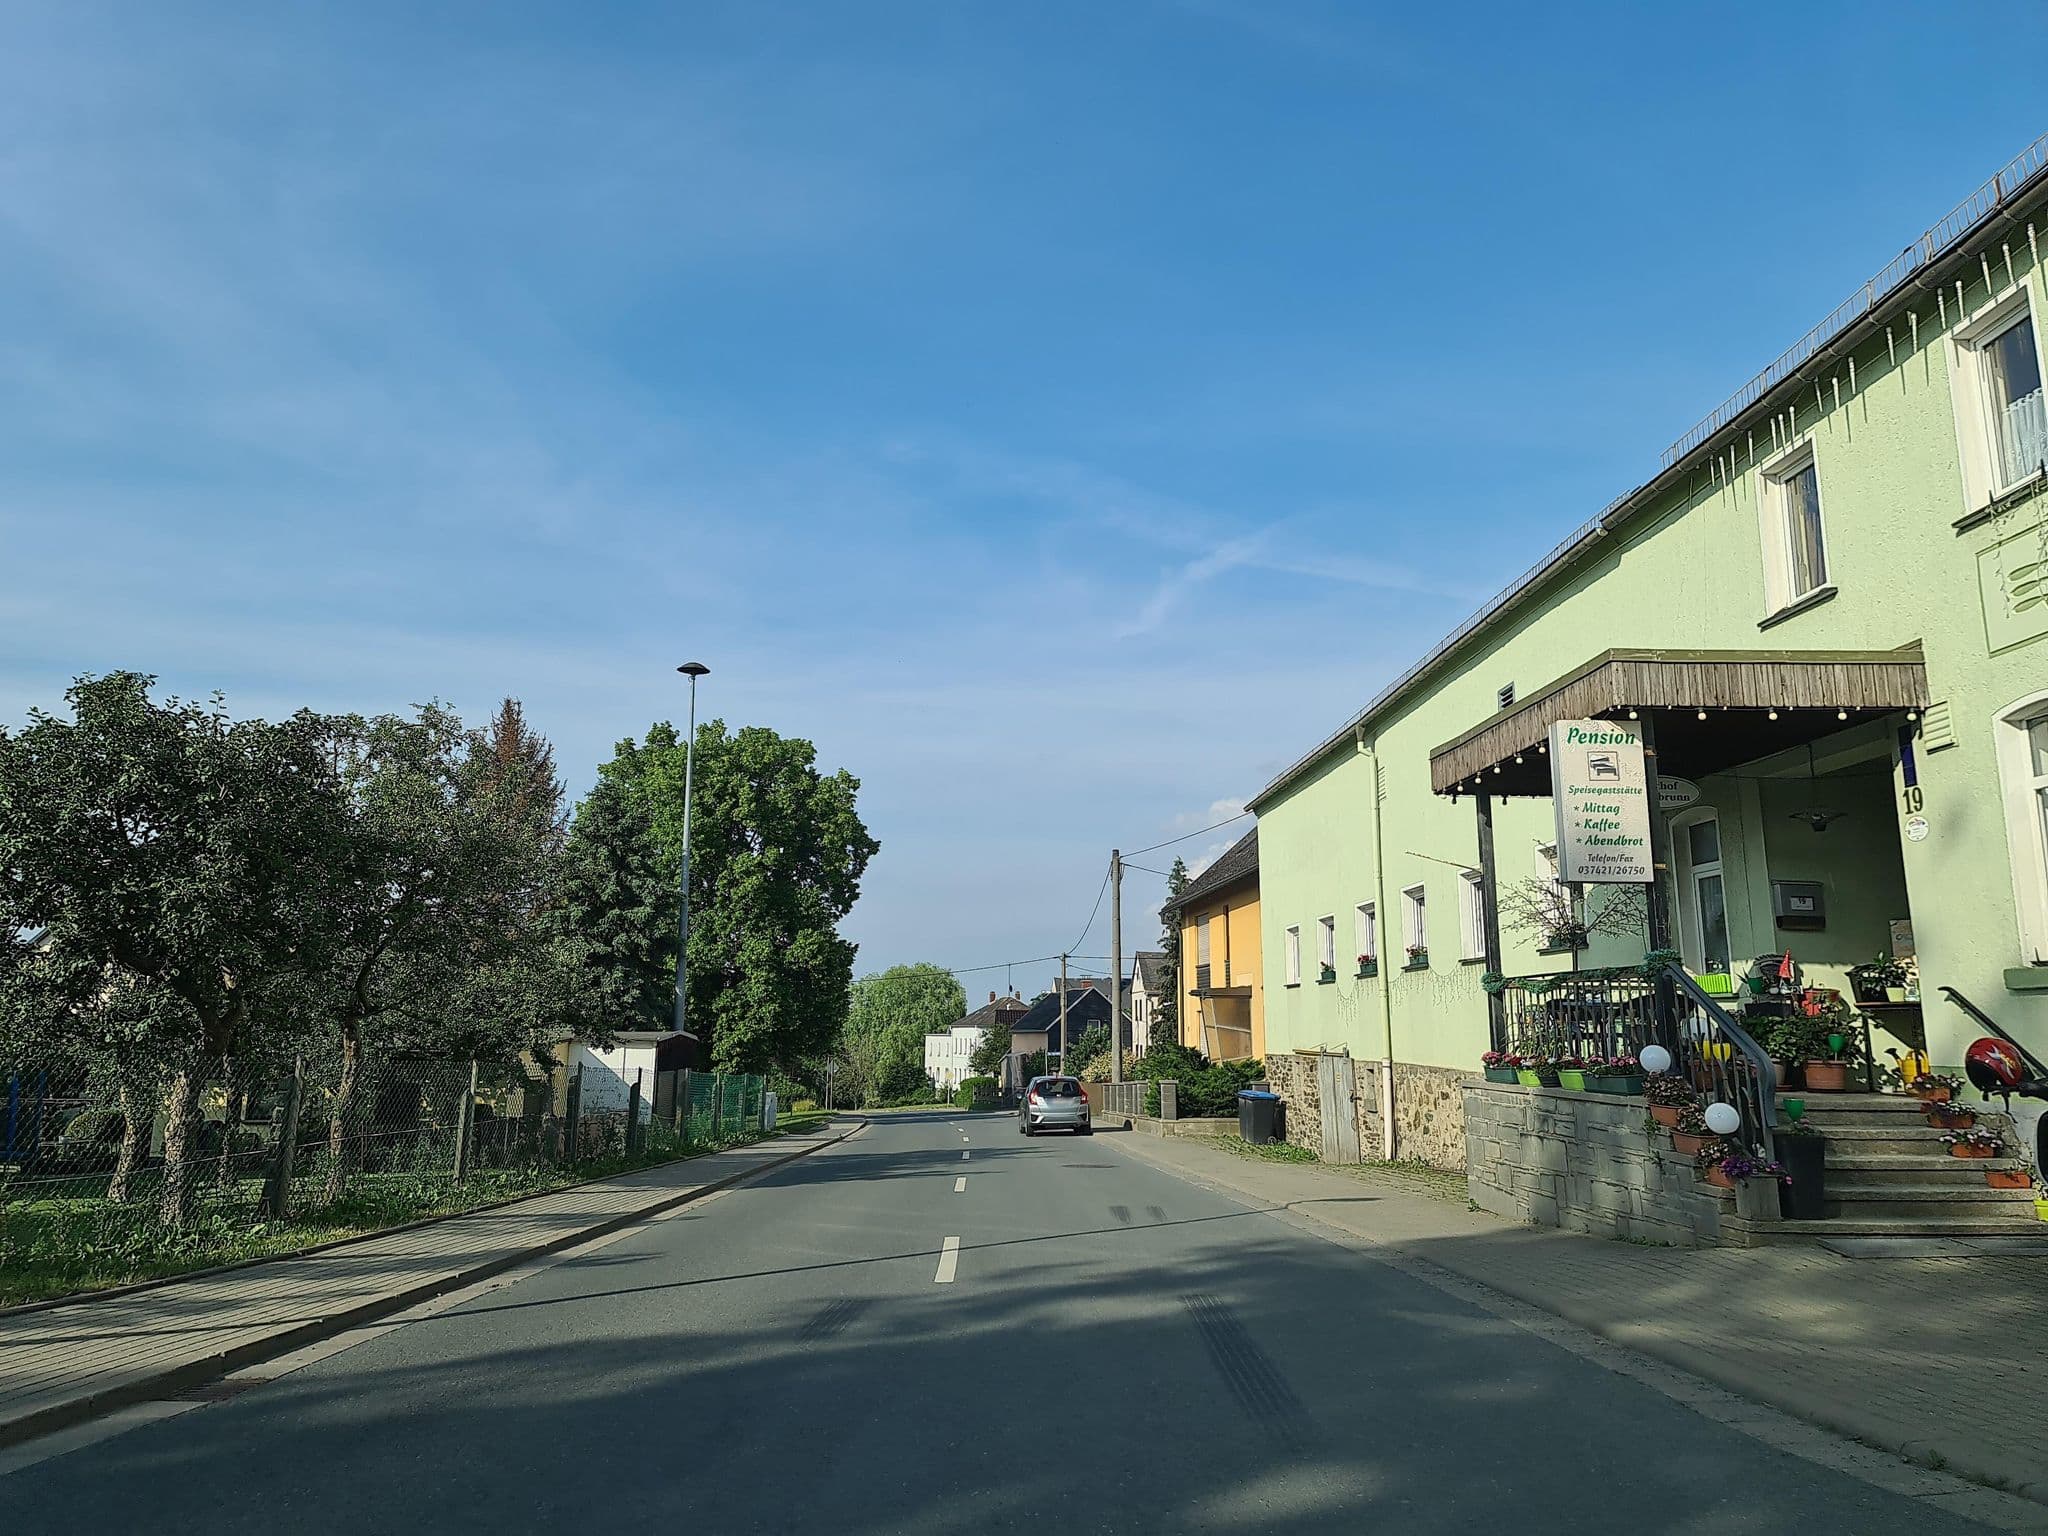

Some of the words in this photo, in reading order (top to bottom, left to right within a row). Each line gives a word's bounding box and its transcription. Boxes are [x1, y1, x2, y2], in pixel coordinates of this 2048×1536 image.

[1567, 727, 1635, 745] Pension
[1568, 785, 1643, 796] Speisegaststätte
[1903, 787, 1923, 814] 19
[1582, 802, 1620, 816] Mittag
[1584, 818, 1621, 832] Kaffee
[1585, 834, 1644, 846] Abendbrot
[1588, 853, 1634, 864] Telefon/Fax
